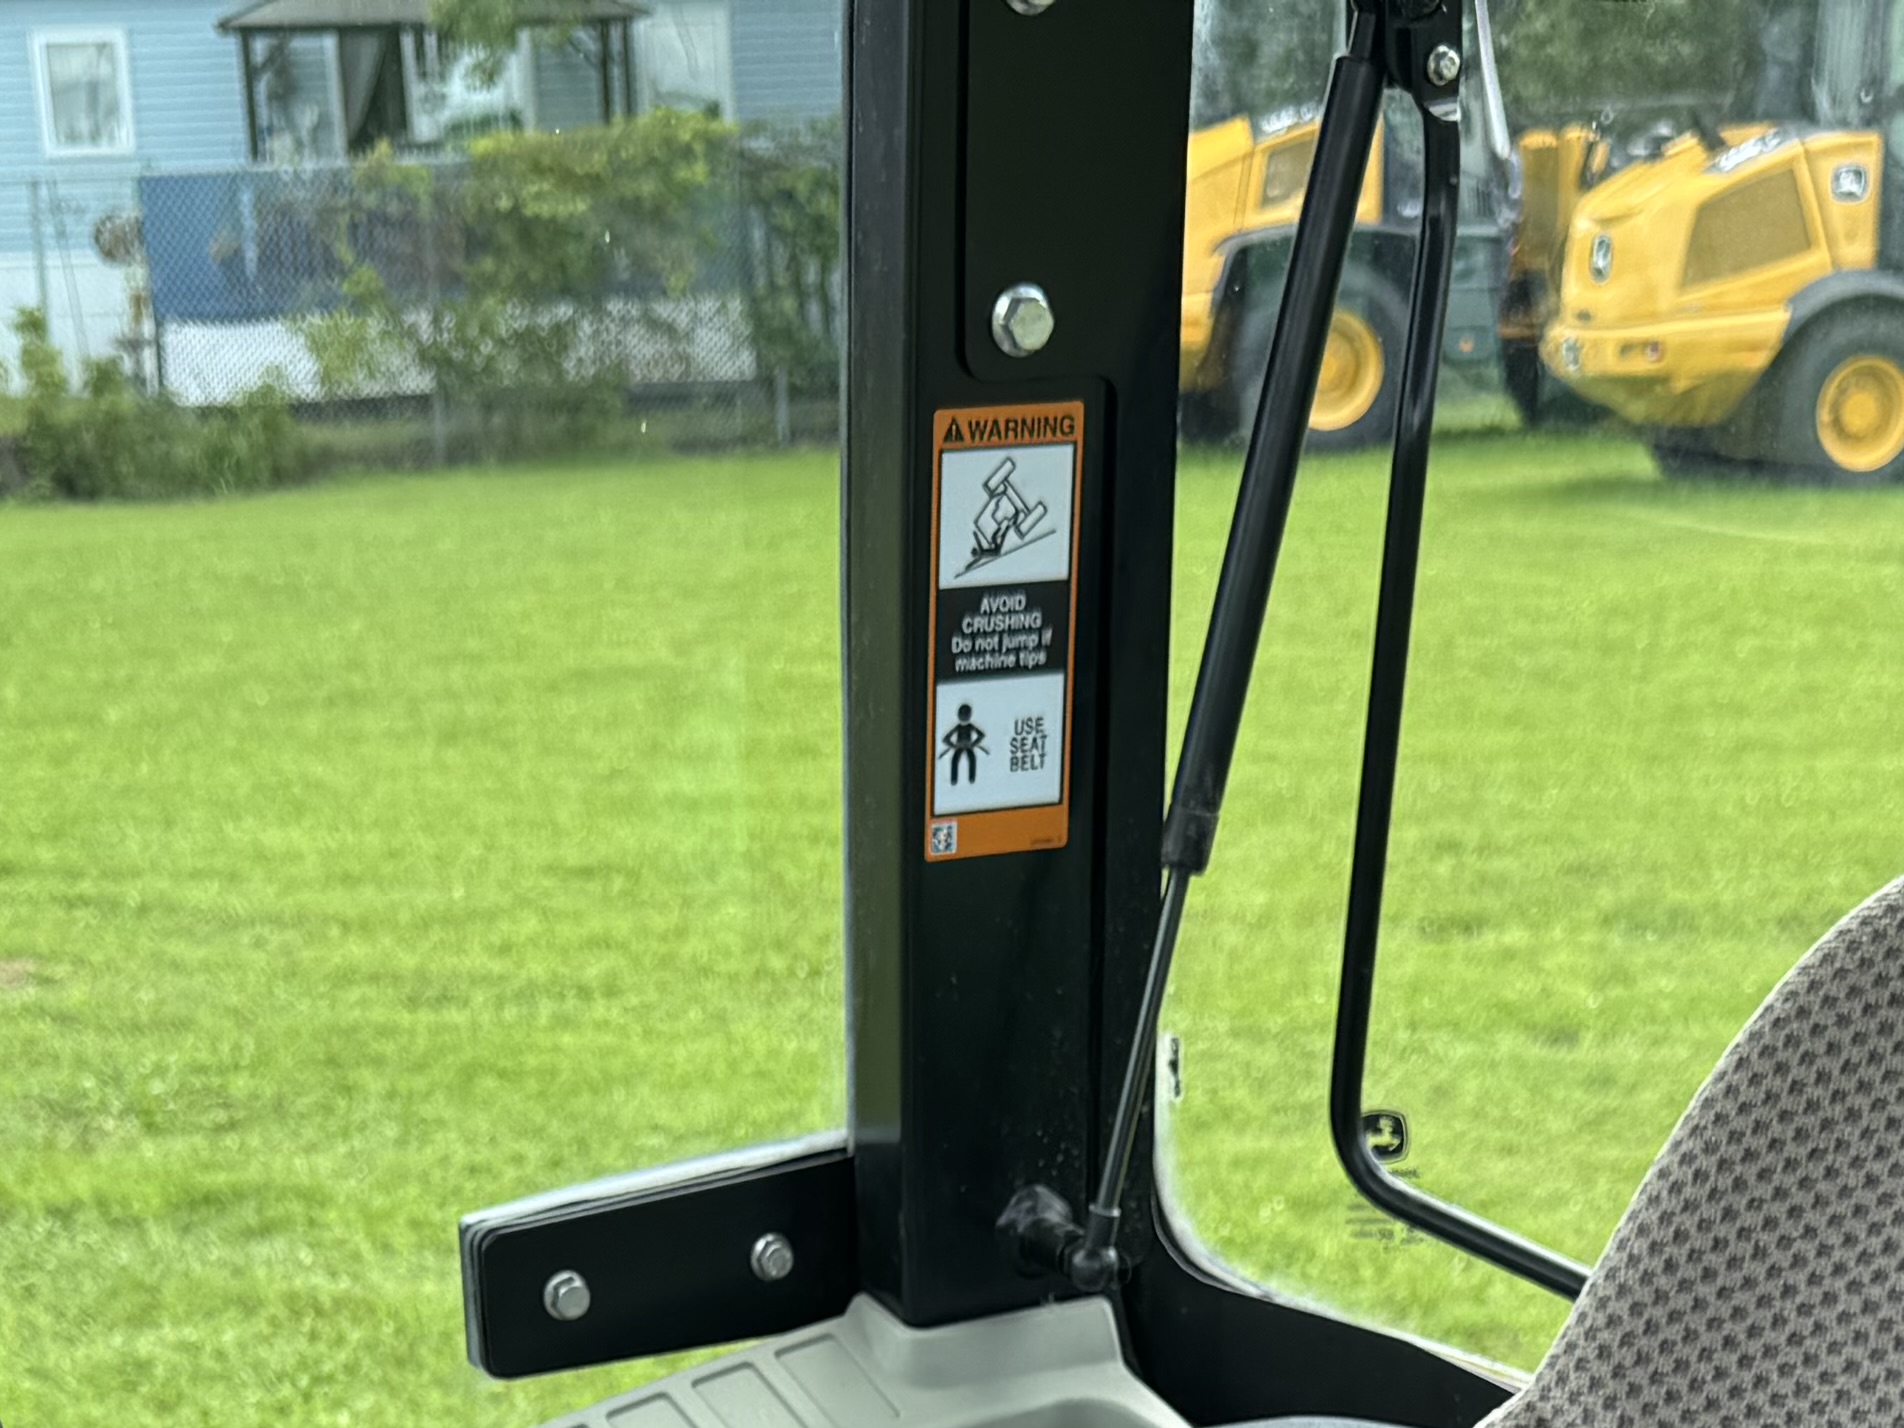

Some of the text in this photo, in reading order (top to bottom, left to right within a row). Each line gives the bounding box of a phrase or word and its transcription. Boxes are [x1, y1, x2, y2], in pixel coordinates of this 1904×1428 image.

[967, 414, 1075, 442] WARNING
[980, 594, 1027, 614] AVOID
[962, 611, 1043, 635] CRUSHING
[951, 627, 1053, 654] Do not jump if
[955, 649, 1047, 672] machine tips
[1014, 716, 1045, 736] USE
[1009, 734, 1047, 755] SEAT
[1009, 753, 1047, 772] BELT
